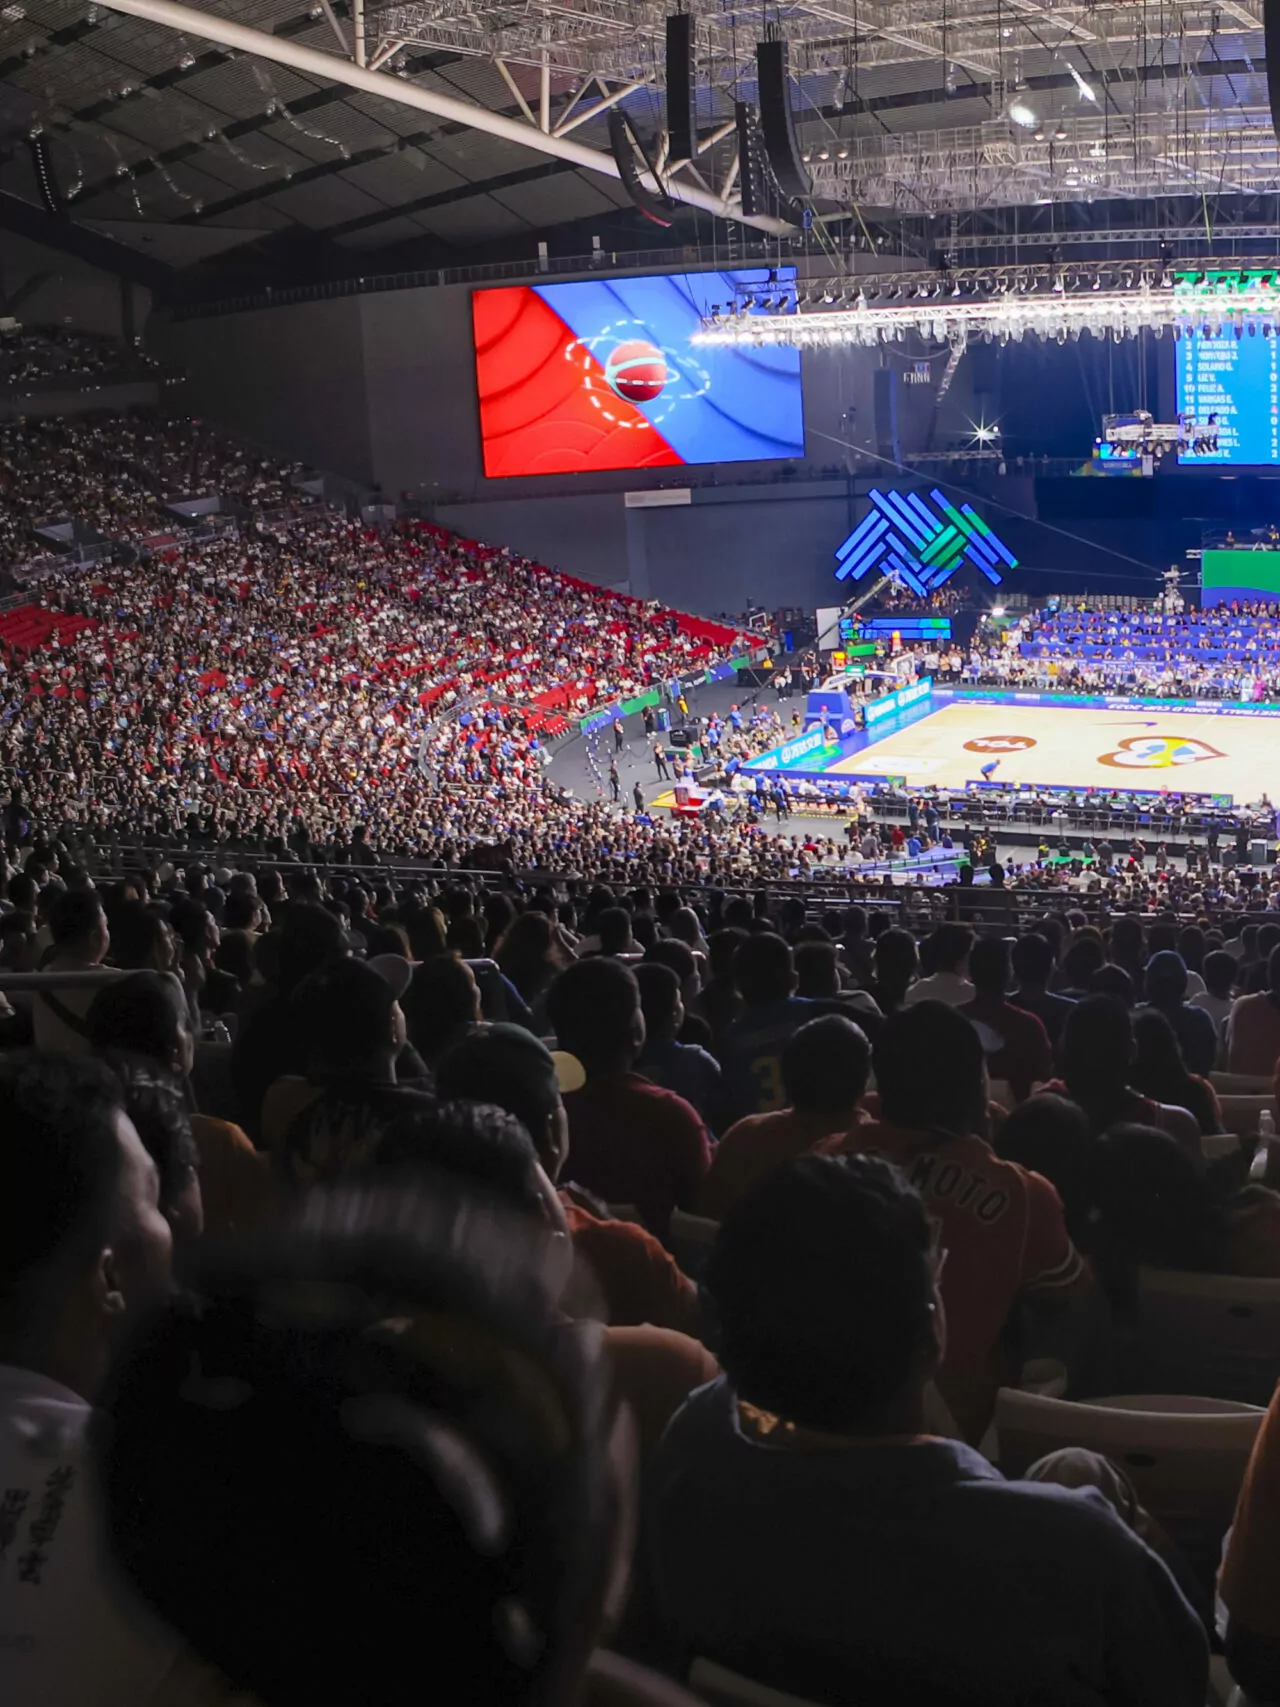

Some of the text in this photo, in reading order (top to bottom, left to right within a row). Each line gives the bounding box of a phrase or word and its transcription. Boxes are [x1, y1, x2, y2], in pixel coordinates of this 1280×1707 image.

[1107, 702, 1143, 711] 2023
[1143, 704, 1171, 712] CUP
[1171, 705, 1218, 714] WORLD
